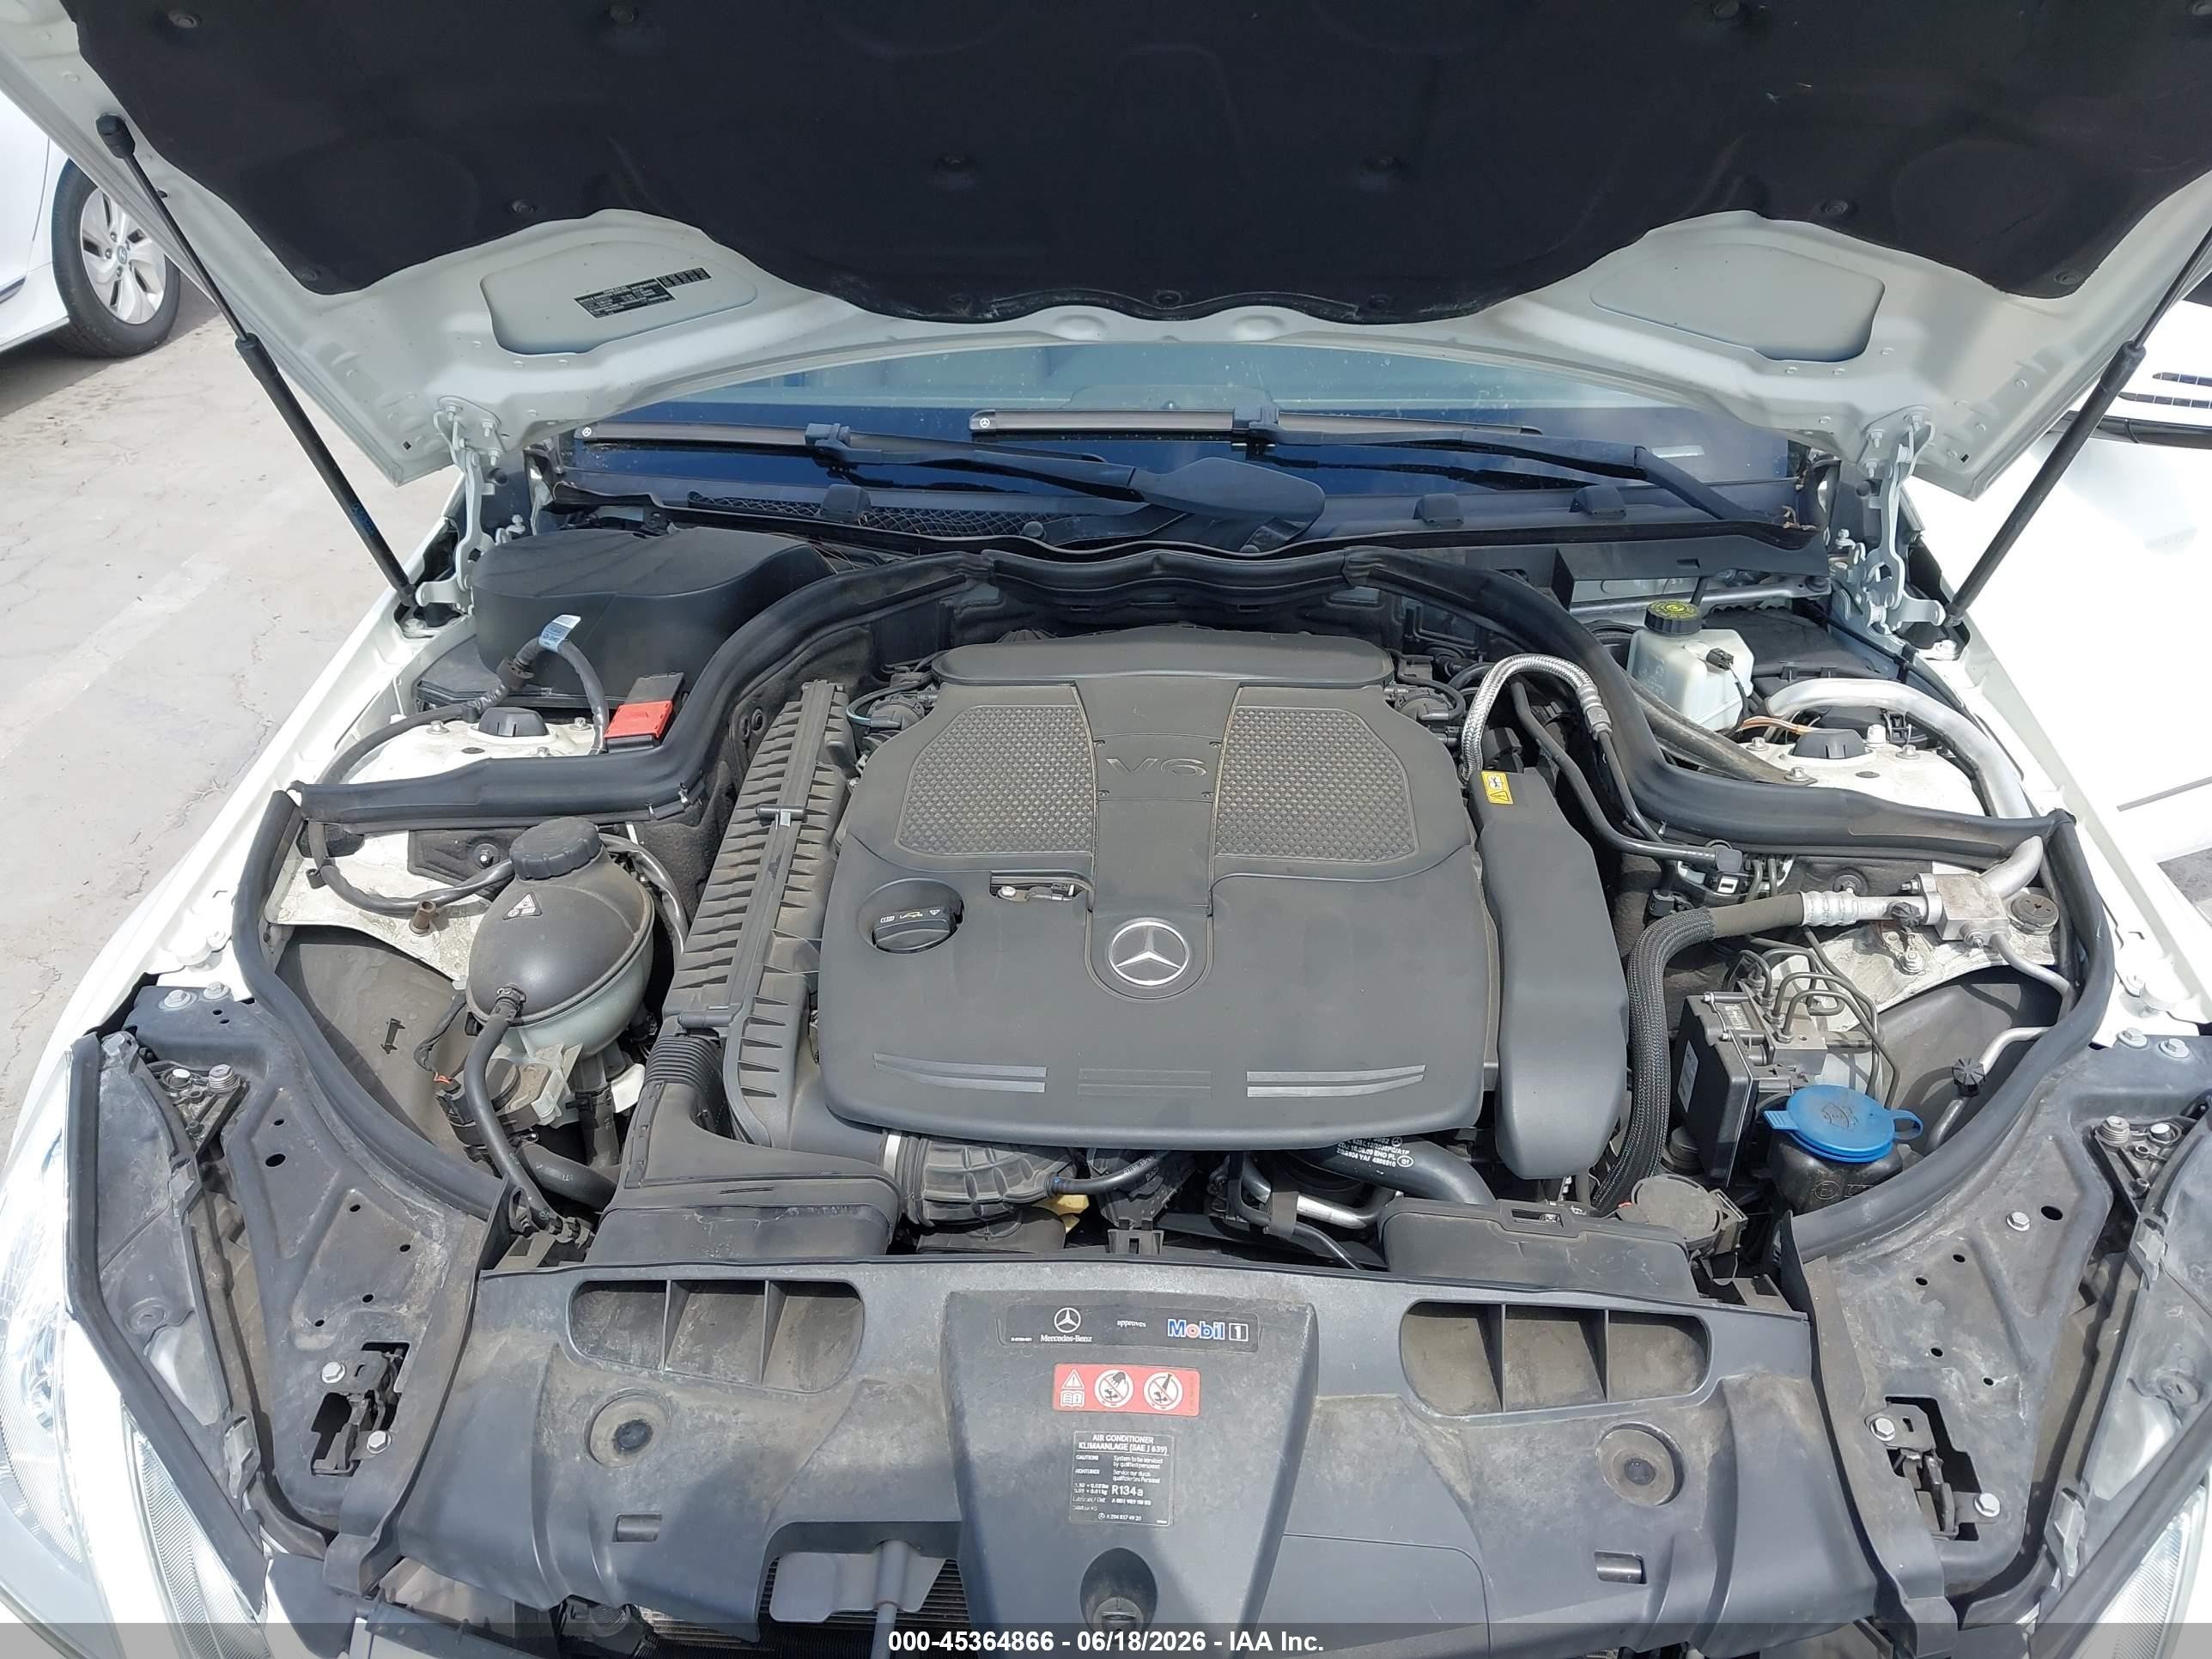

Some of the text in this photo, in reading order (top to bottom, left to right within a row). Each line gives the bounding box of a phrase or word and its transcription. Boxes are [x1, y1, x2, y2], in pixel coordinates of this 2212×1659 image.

[1106, 757, 1206, 776] V6
[1116, 1319, 1147, 1328] approves
[1167, 1318, 1225, 1340] Mobil
[1040, 1333, 1093, 1343] Mercedes-Benz
[1105, 1434, 1154, 1443] CONDITIONER
[1079, 1442, 1129, 1451] KLIMAANLAGE
[1111, 1484, 1144, 1497] R134a
